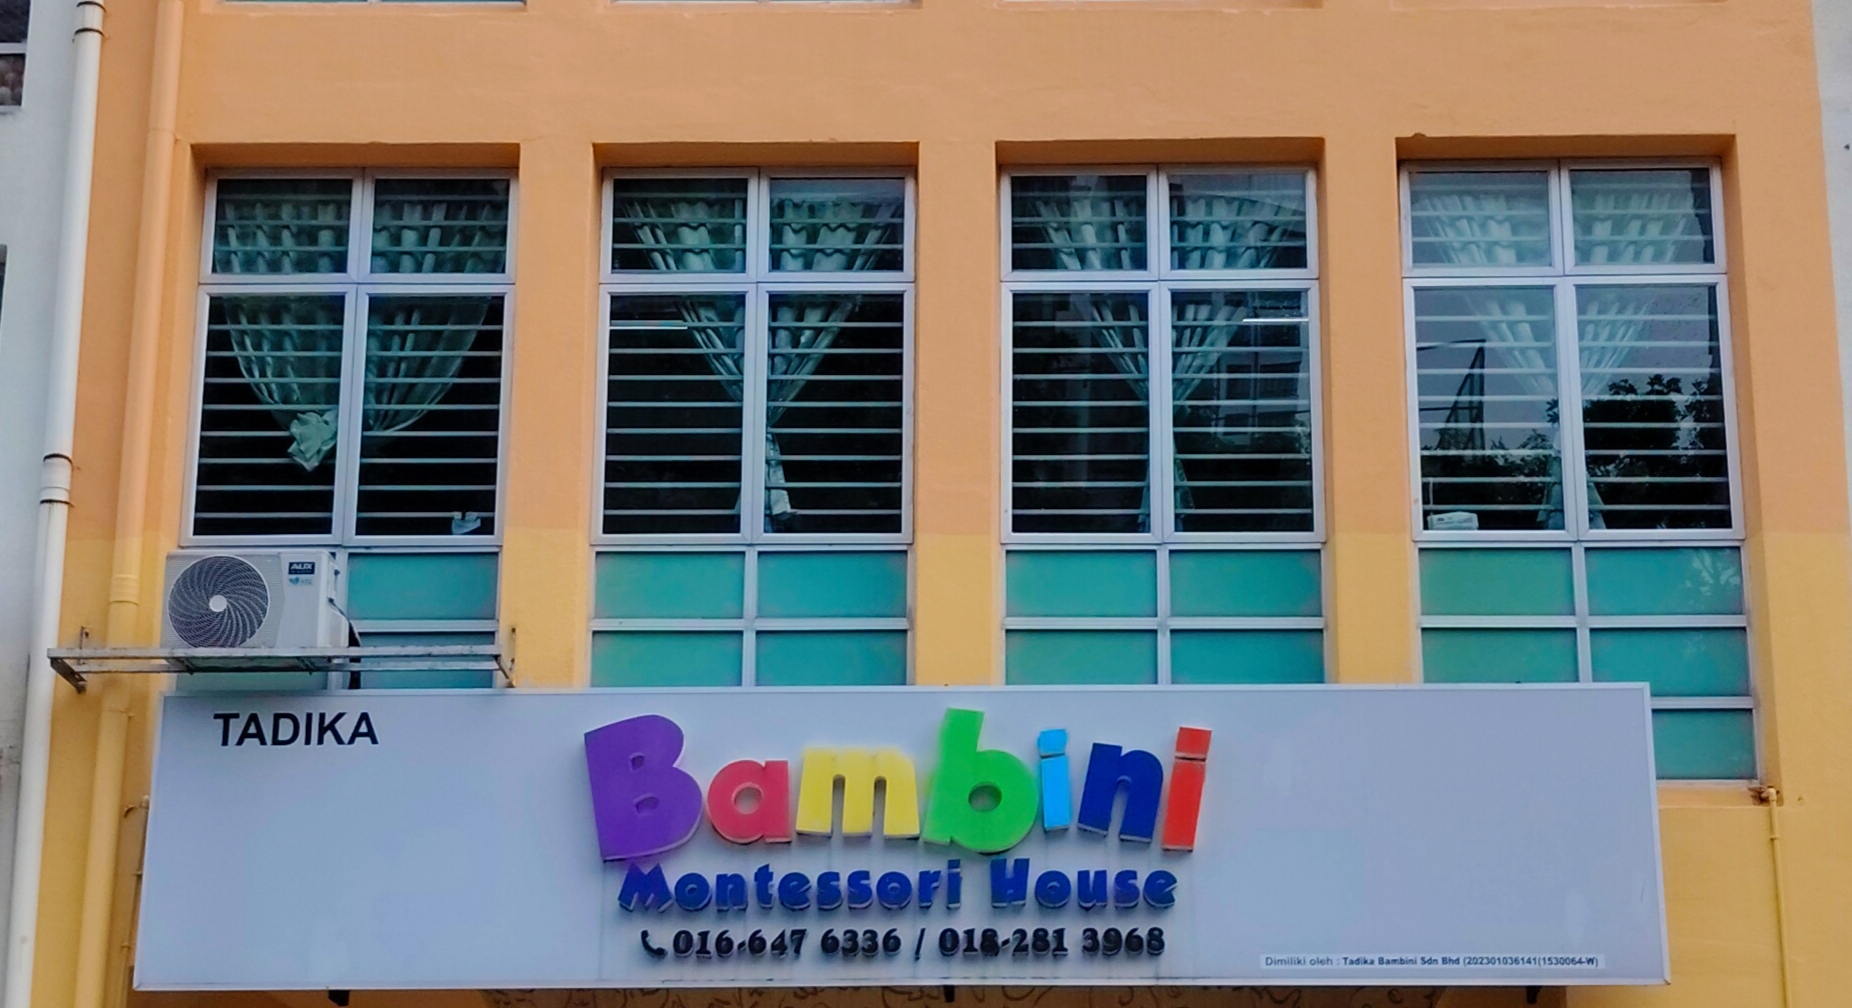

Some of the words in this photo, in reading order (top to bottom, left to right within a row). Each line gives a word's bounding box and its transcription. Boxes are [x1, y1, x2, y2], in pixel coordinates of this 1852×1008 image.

[290, 562, 314, 570] AUX
[213, 711, 379, 746] TADIKA
[584, 707, 1213, 861] Bambini
[618, 859, 963, 912] Montessori
[990, 857, 1178, 909] House
[672, 928, 807, 959] 016-647
[820, 928, 902, 957] 6336
[939, 927, 1069, 957] 018-281
[1082, 927, 1165, 956] 3968
[1265, 956, 1306, 966] Dimiliki
[1309, 956, 1333, 966] oleh
[1342, 956, 1375, 966] Tadika
[1378, 956, 1418, 966] Bambini
[1420, 956, 1438, 966] Sdn
[1441, 956, 1460, 966] Bhd
